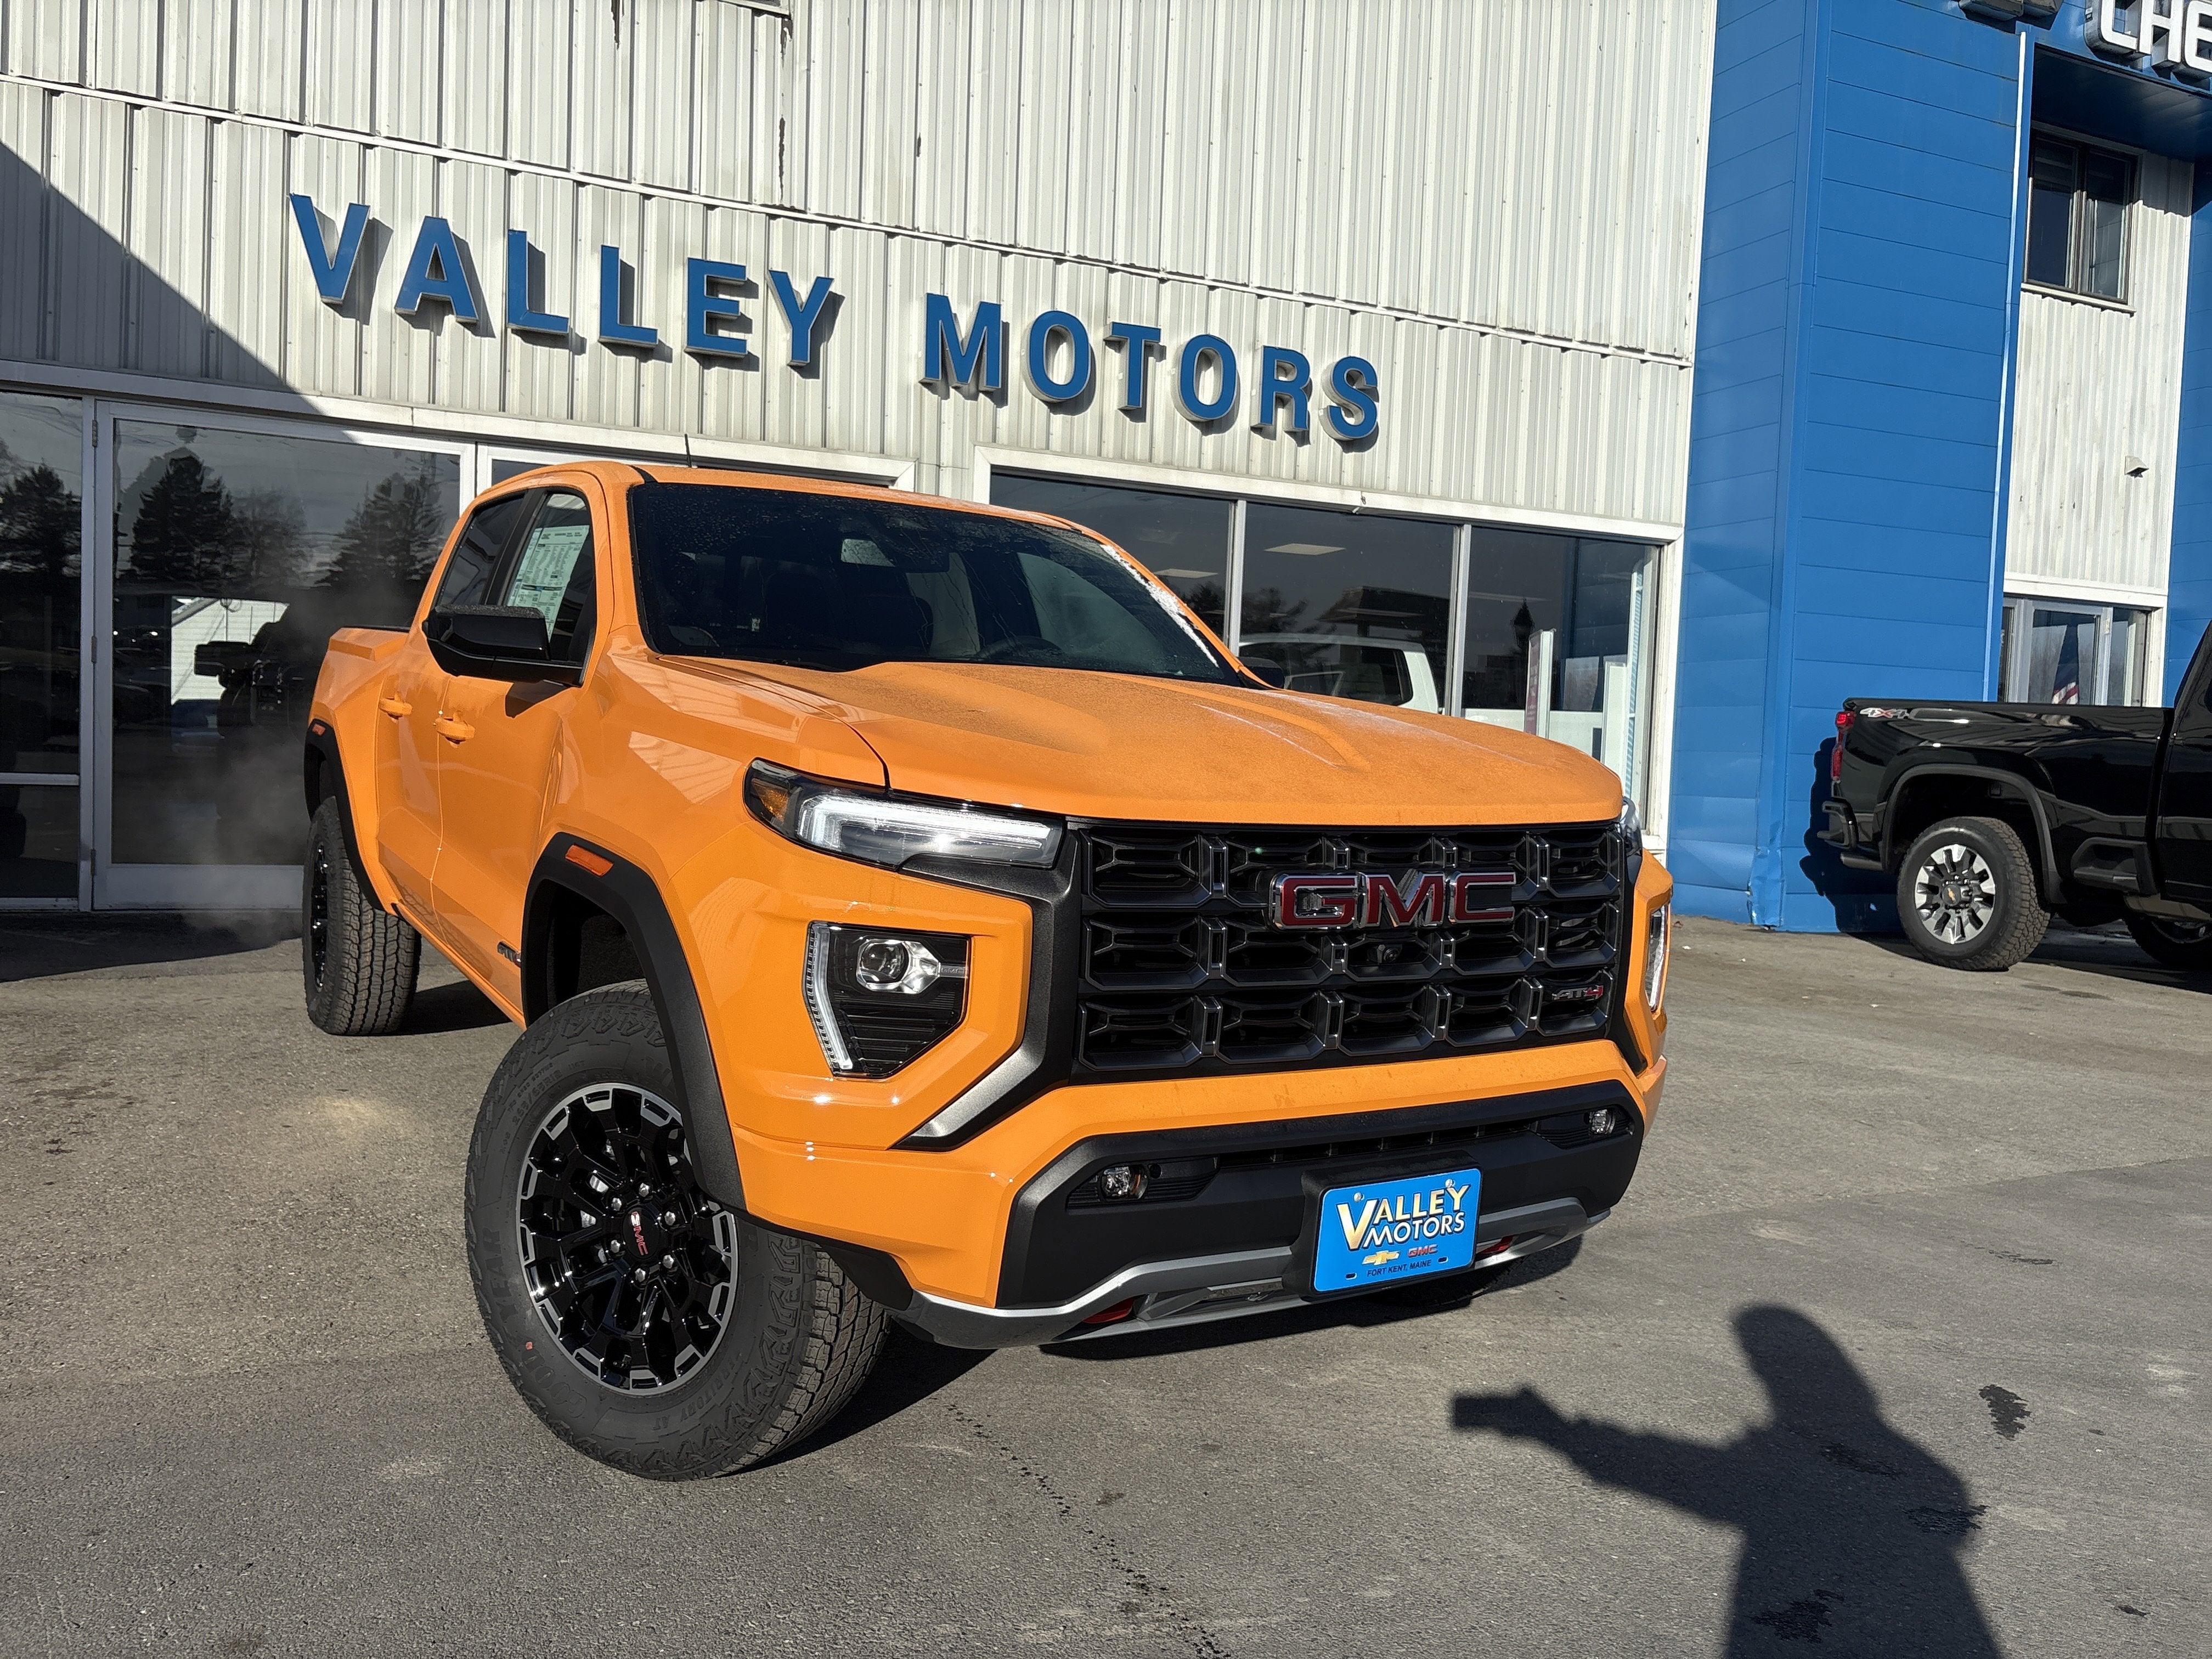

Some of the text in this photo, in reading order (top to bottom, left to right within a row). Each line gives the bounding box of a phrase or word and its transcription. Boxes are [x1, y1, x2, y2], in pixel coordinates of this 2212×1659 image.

[289, 193, 1379, 441] VALLEY MOTORS
[1271, 871, 1516, 929] GMC
[630, 1211, 648, 1256] GMC
[1336, 1184, 1471, 1251] VALLEY
[1363, 1211, 1465, 1249] MOTORS
[1367, 1259, 1431, 1277] FORT KENT, MAINE
[1408, 1244, 1438, 1257] GMC
